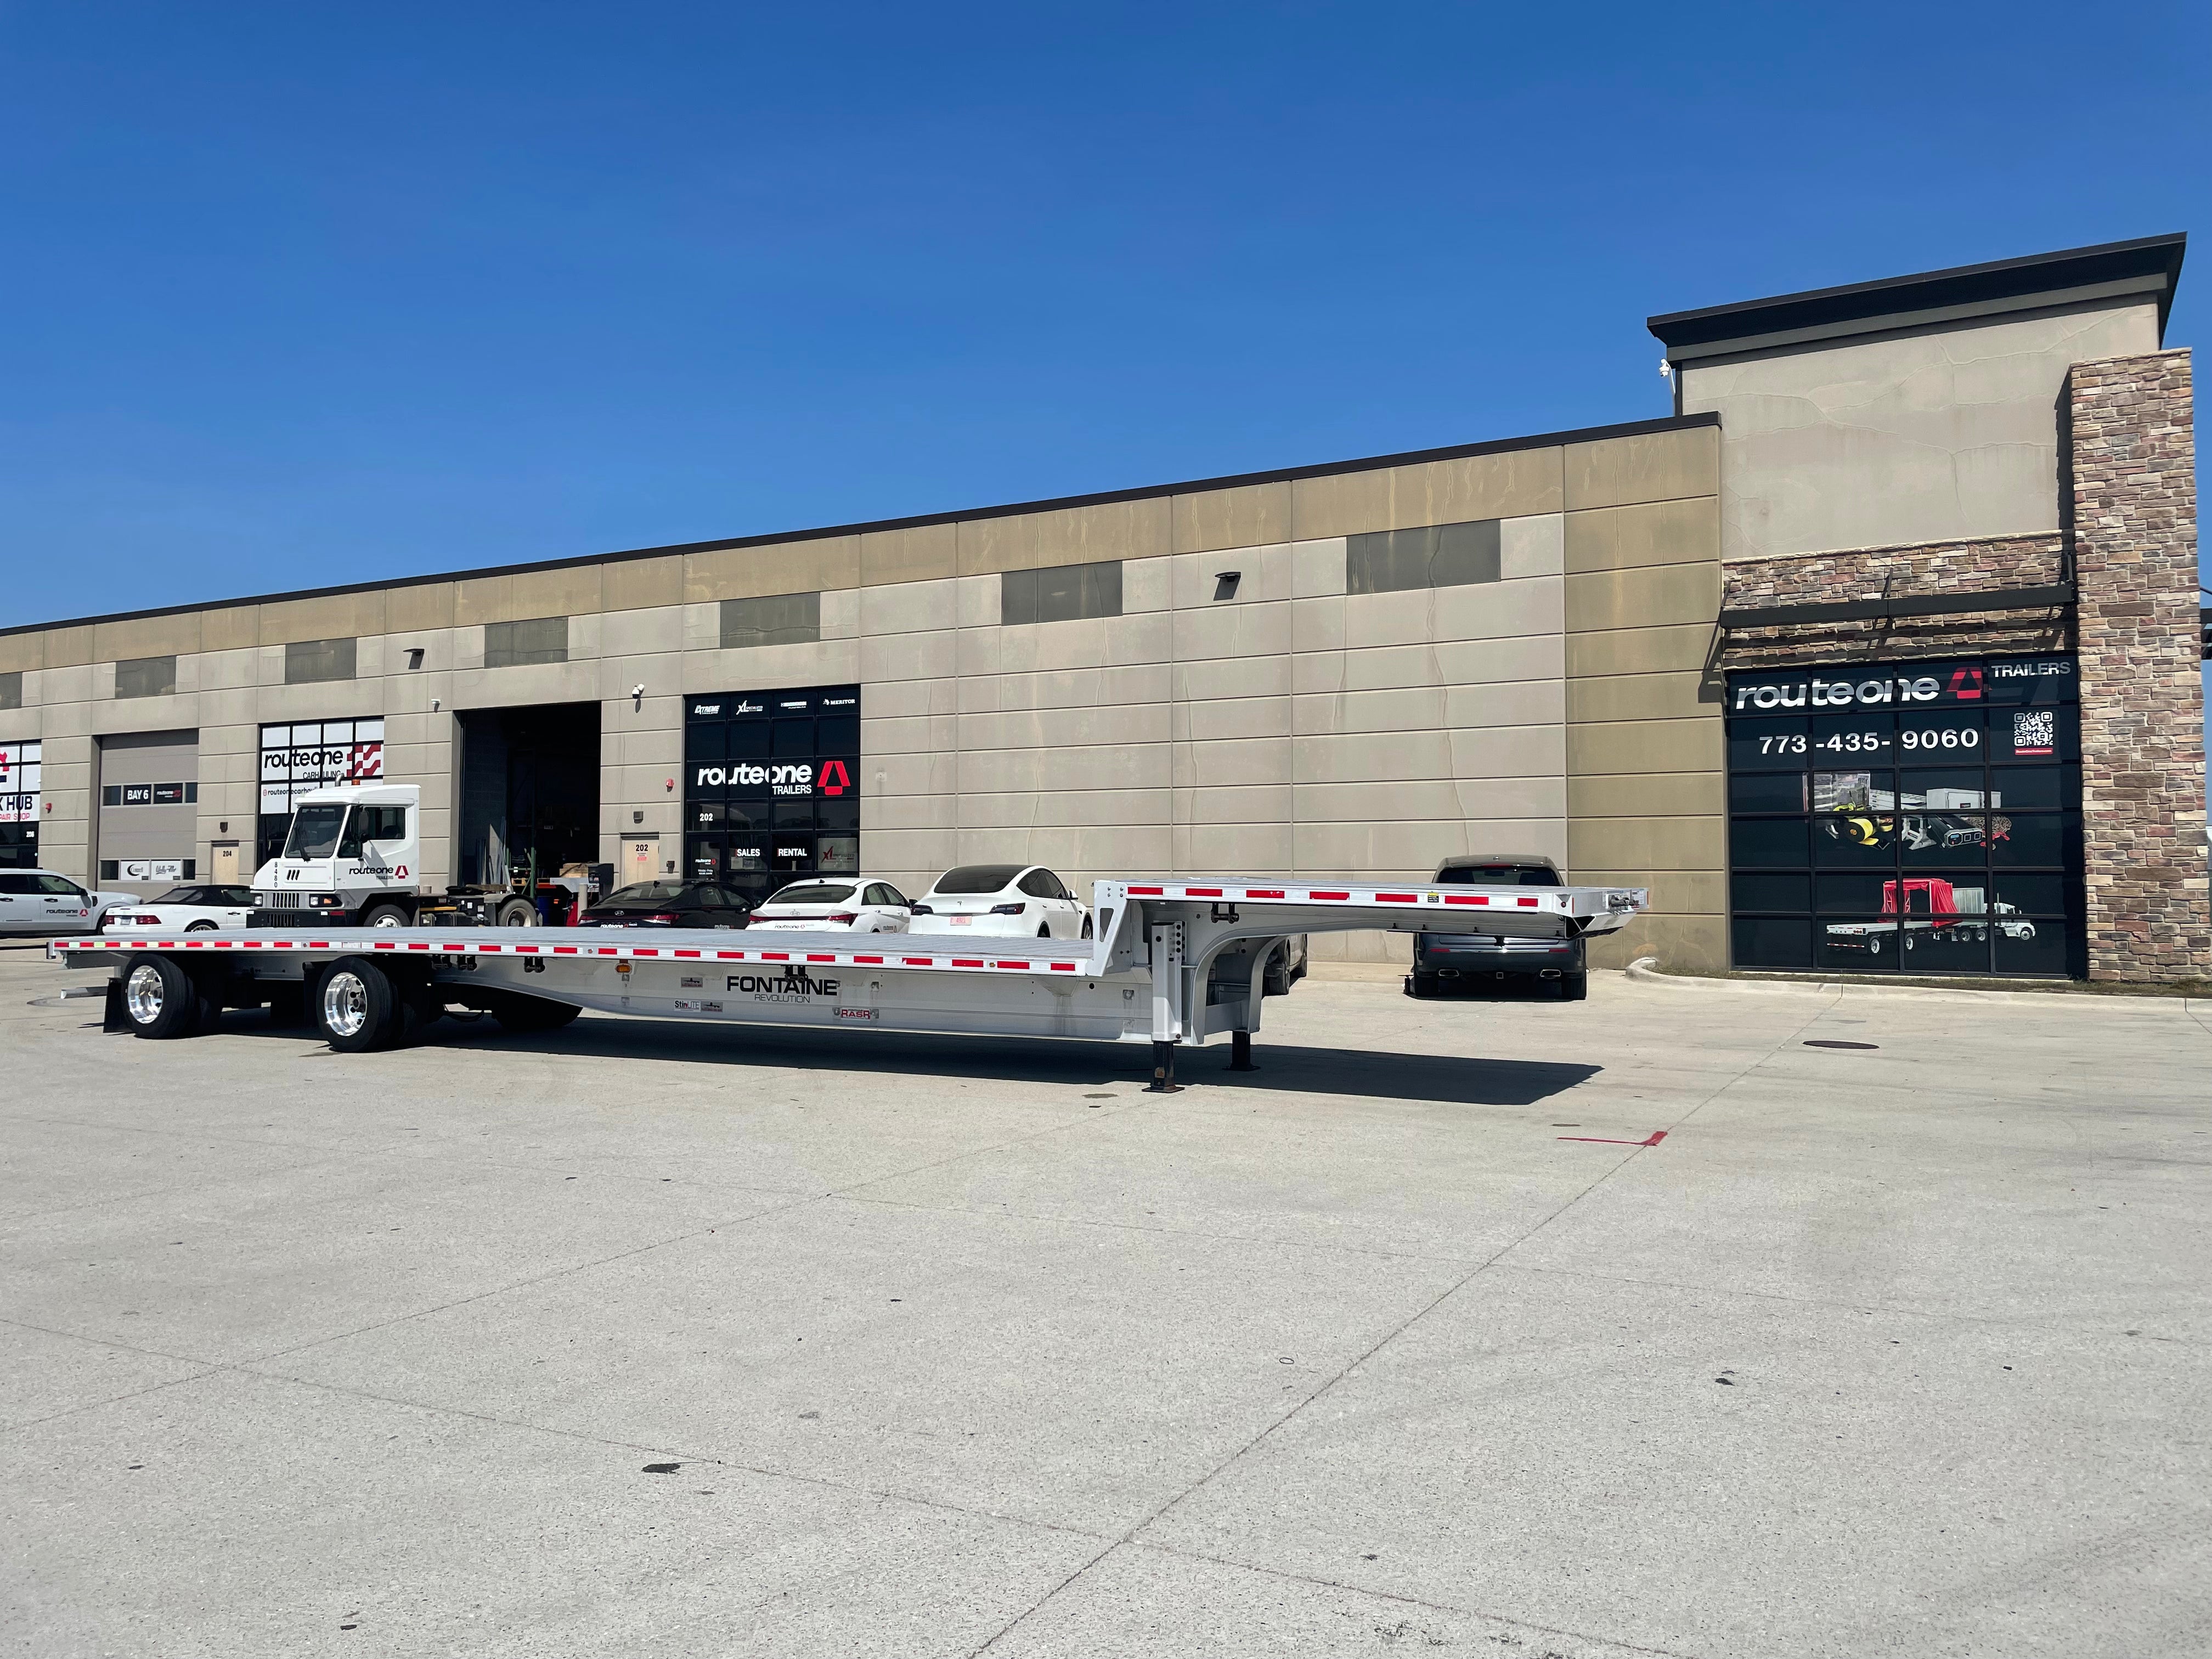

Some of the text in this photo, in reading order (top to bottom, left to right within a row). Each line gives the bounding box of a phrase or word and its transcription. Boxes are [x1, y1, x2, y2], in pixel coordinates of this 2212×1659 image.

[1991, 662, 2071, 678] TRAILERS
[1736, 678, 1940, 709] routeone
[1901, 729, 1978, 749] 9060
[264, 748, 343, 768] routeone
[303, 770, 341, 778] CARHULING
[697, 763, 812, 786] routeone
[127, 789, 149, 800] BAY 6
[772, 785, 812, 795] TRAILERS
[6, 795, 32, 811] HUB
[699, 813, 713, 821] 202
[778, 848, 807, 856] RENTAL
[349, 866, 393, 874] routeone
[727, 976, 837, 995] FONTAINE
[754, 994, 810, 1003] REVOLUTION
[840, 1009, 871, 1019] RASR
